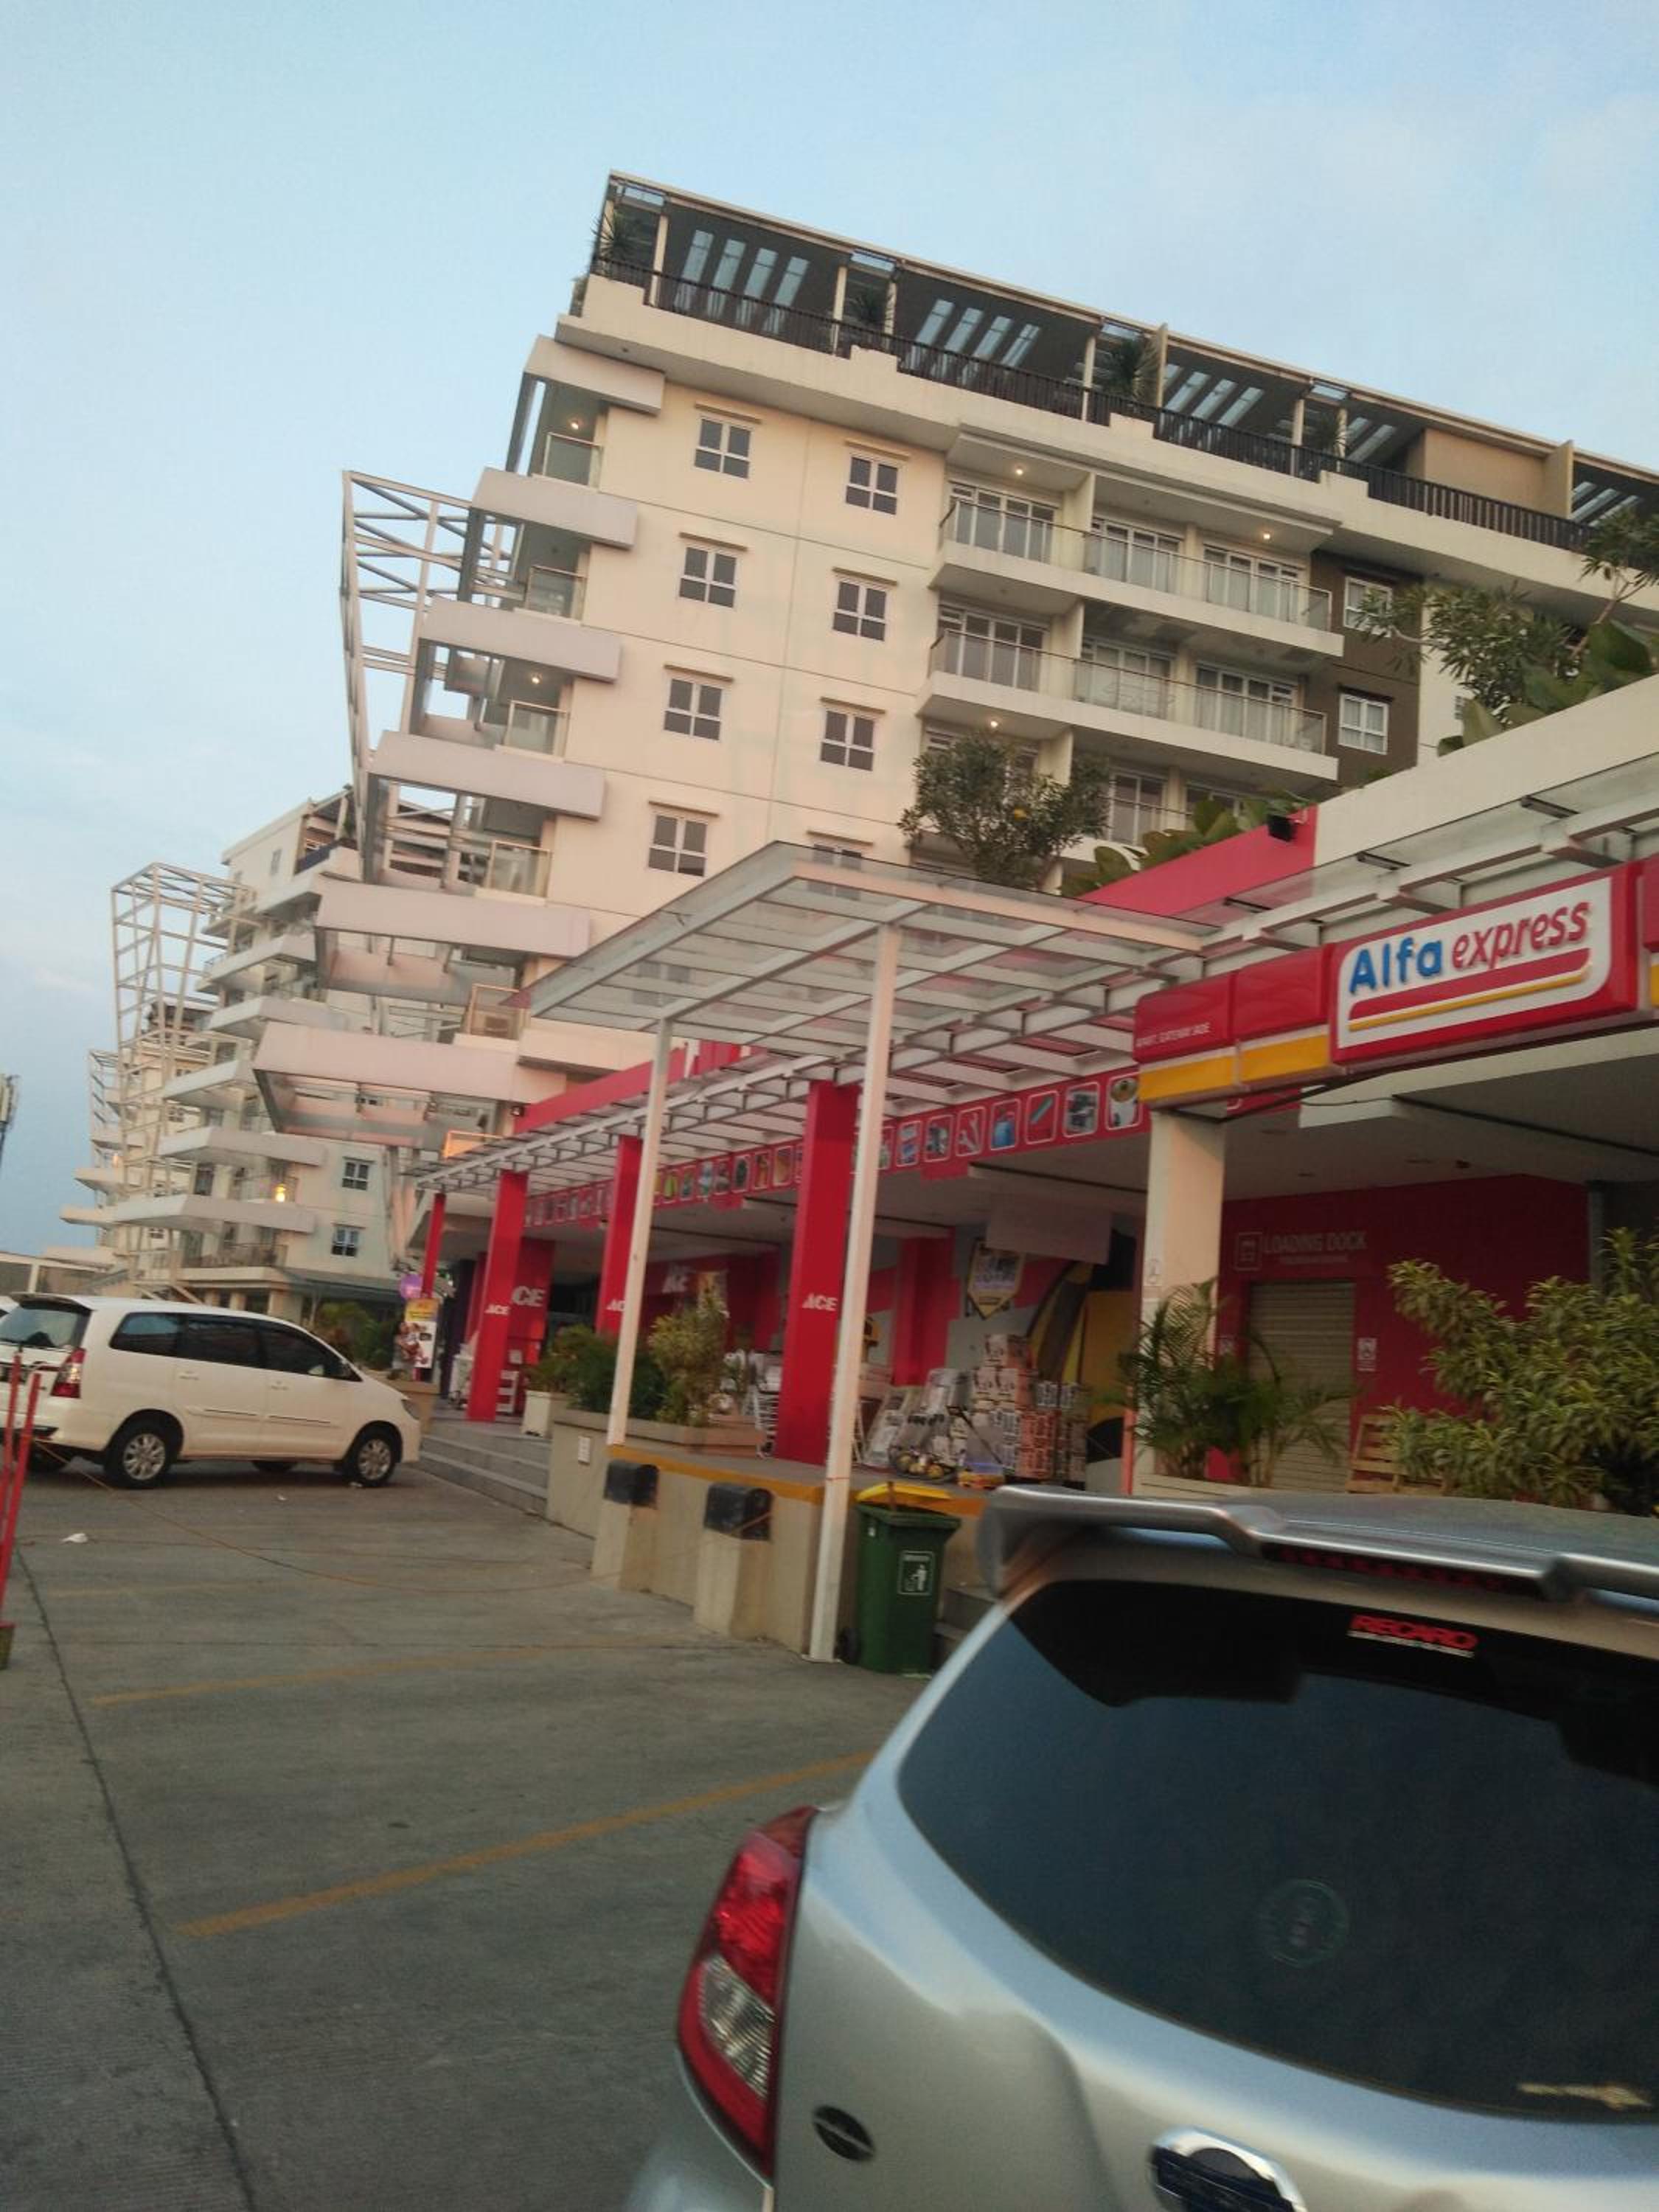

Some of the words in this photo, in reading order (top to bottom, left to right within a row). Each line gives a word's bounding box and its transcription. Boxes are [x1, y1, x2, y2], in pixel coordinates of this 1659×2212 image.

[1349, 936, 1443, 994] Alfa
[1450, 902, 1590, 970] express
[1262, 1234, 1323, 1254] LOADING
[1327, 1231, 1367, 1251] DOCK
[512, 1286, 546, 1307] CE
[605, 1298, 625, 1312] AC
[801, 1293, 838, 1312] ACE
[484, 1304, 509, 1315] ACE
[1351, 1614, 1479, 1652] RECARO
